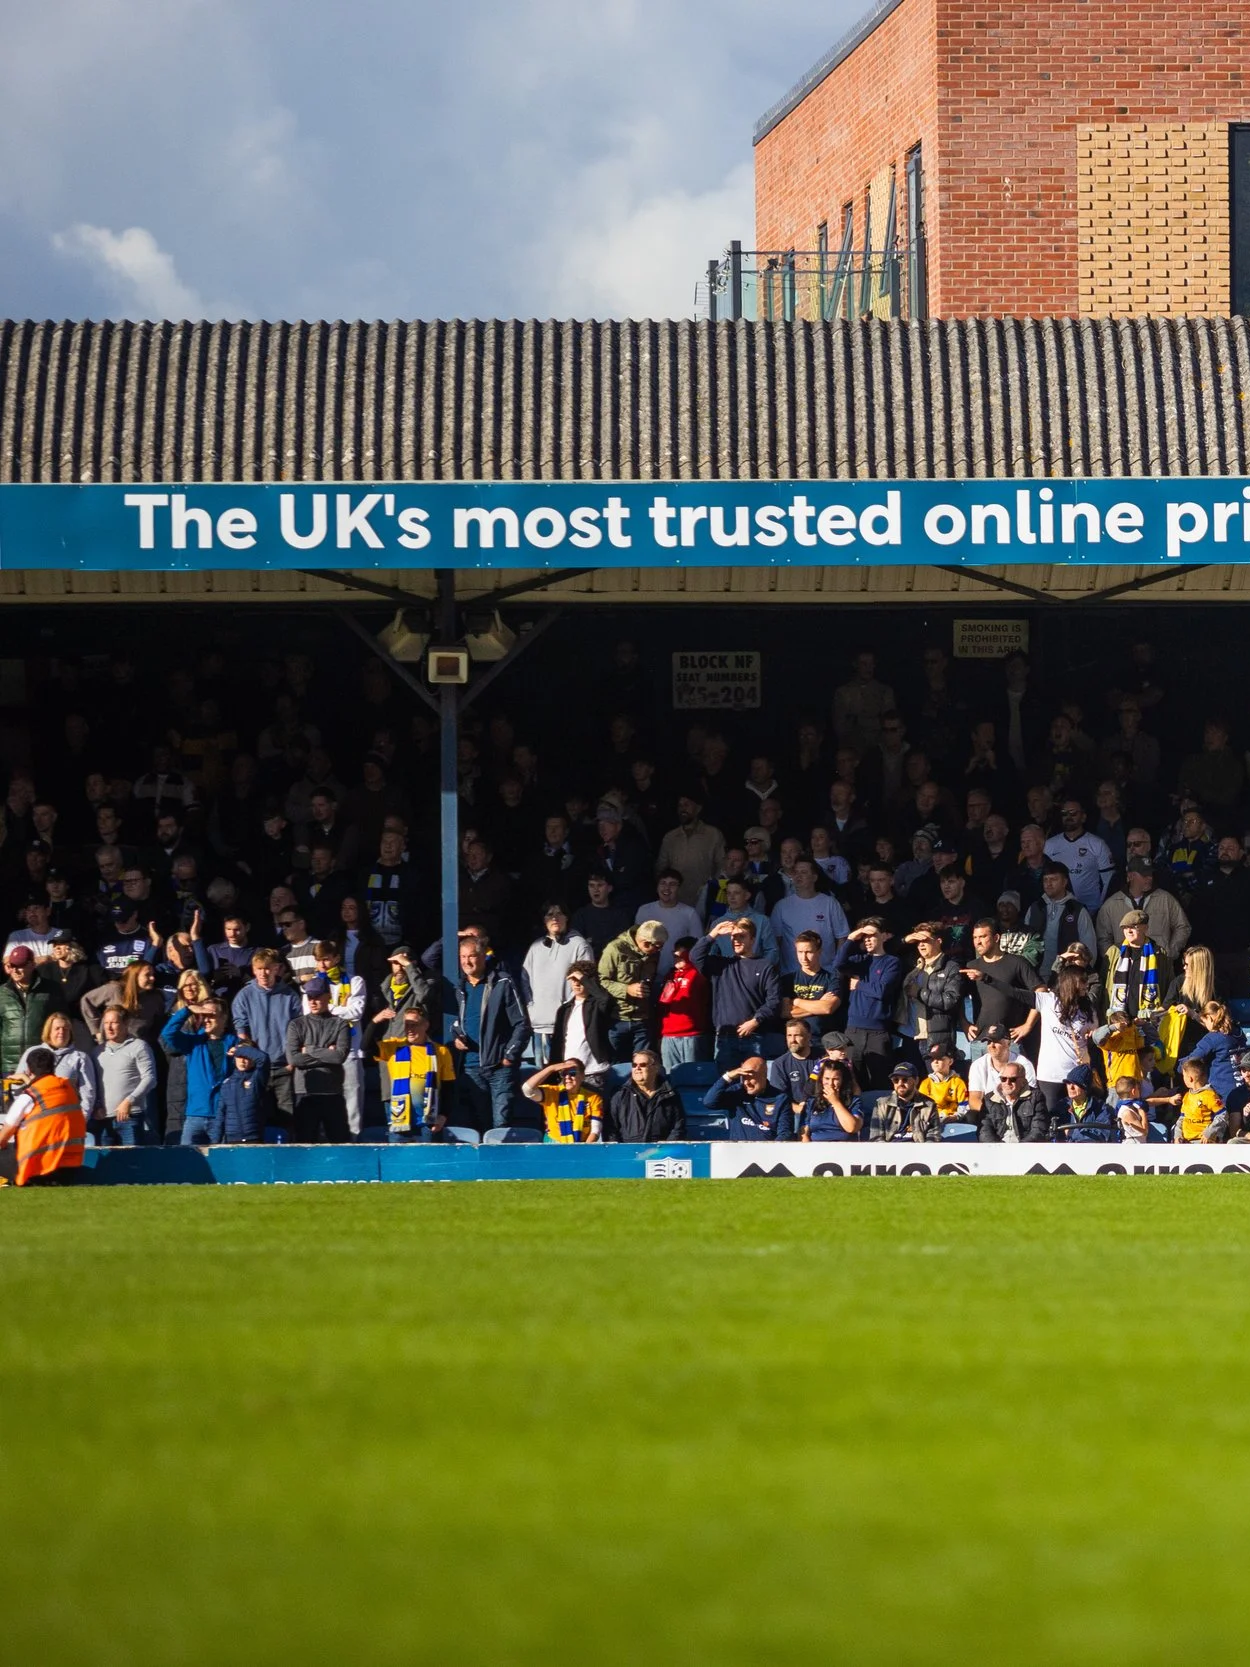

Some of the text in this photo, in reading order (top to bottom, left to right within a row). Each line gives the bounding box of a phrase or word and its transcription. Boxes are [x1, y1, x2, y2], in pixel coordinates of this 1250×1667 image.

[125, 494, 257, 550] The
[280, 494, 431, 550] UK's
[453, 497, 632, 549] most
[648, 490, 902, 548] trusted
[923, 487, 1144, 546] online
[961, 624, 1022, 633] SMOKING IS
[960, 634, 1021, 643] PROHIBITED
[958, 645, 968, 654] IN
[971, 645, 994, 654] THIS
[679, 655, 754, 669] BLOCK NF
[676, 672, 758, 682] SEAT NUMBERS
